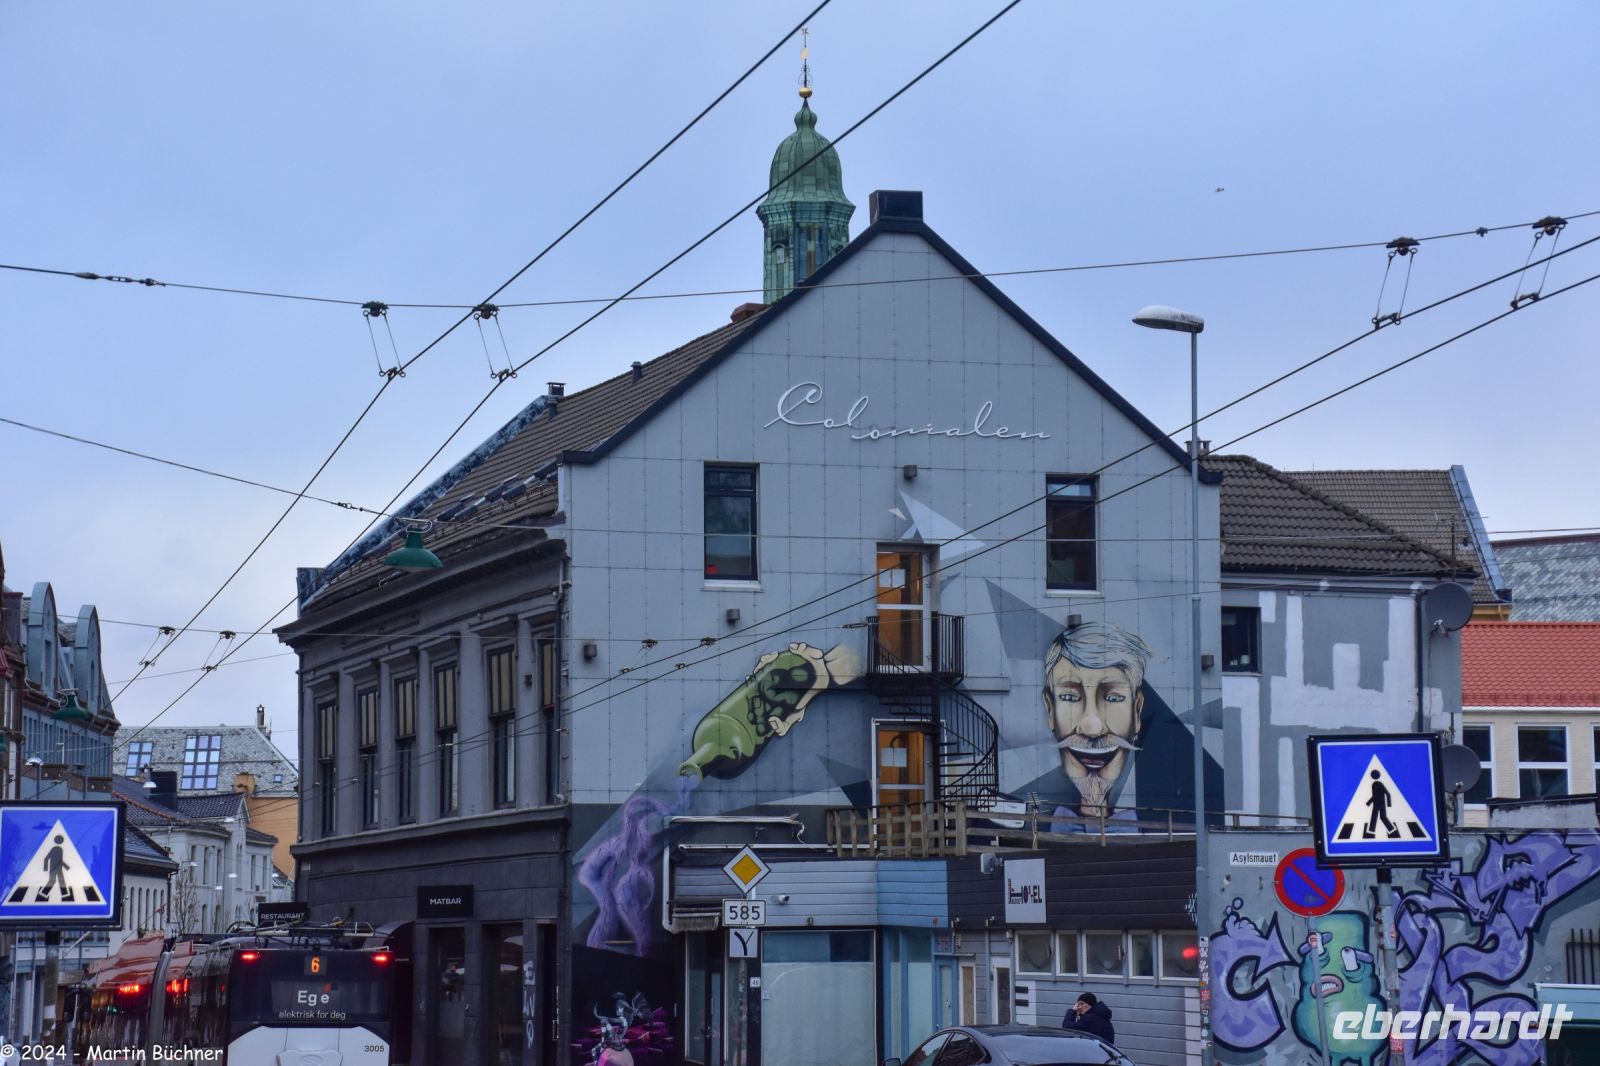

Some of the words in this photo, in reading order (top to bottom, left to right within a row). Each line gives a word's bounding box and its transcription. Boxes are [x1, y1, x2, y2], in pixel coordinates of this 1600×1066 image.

[763, 381, 1052, 440] Colonialen
[1232, 852, 1277, 865] Asylsmauet
[429, 897, 462, 905] MATBAR
[260, 912, 305, 920] RESTAURANT
[729, 905, 761, 920] 585
[311, 957, 321, 973] 6
[279, 1010, 315, 1019] elektrisk
[317, 1010, 329, 1019] for
[330, 1010, 346, 1021] deg
[364, 1045, 385, 1053] 3005
